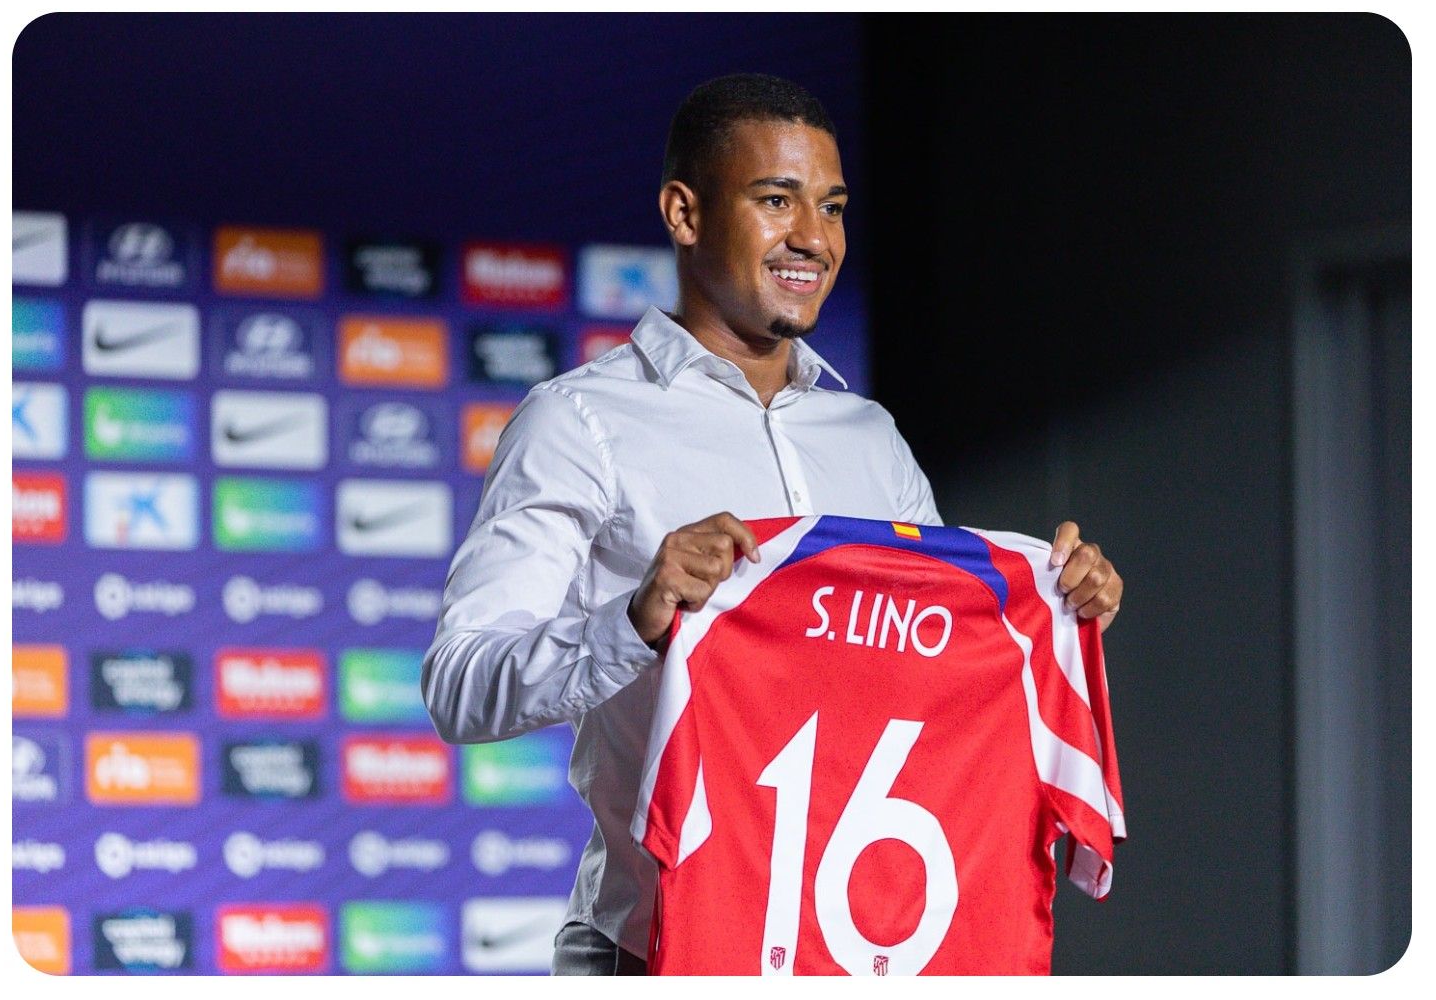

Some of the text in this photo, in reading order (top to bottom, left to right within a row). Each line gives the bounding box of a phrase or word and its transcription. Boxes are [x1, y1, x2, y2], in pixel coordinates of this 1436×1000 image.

[804, 585, 954, 658] S. LINO
[754, 708, 960, 977] 16
